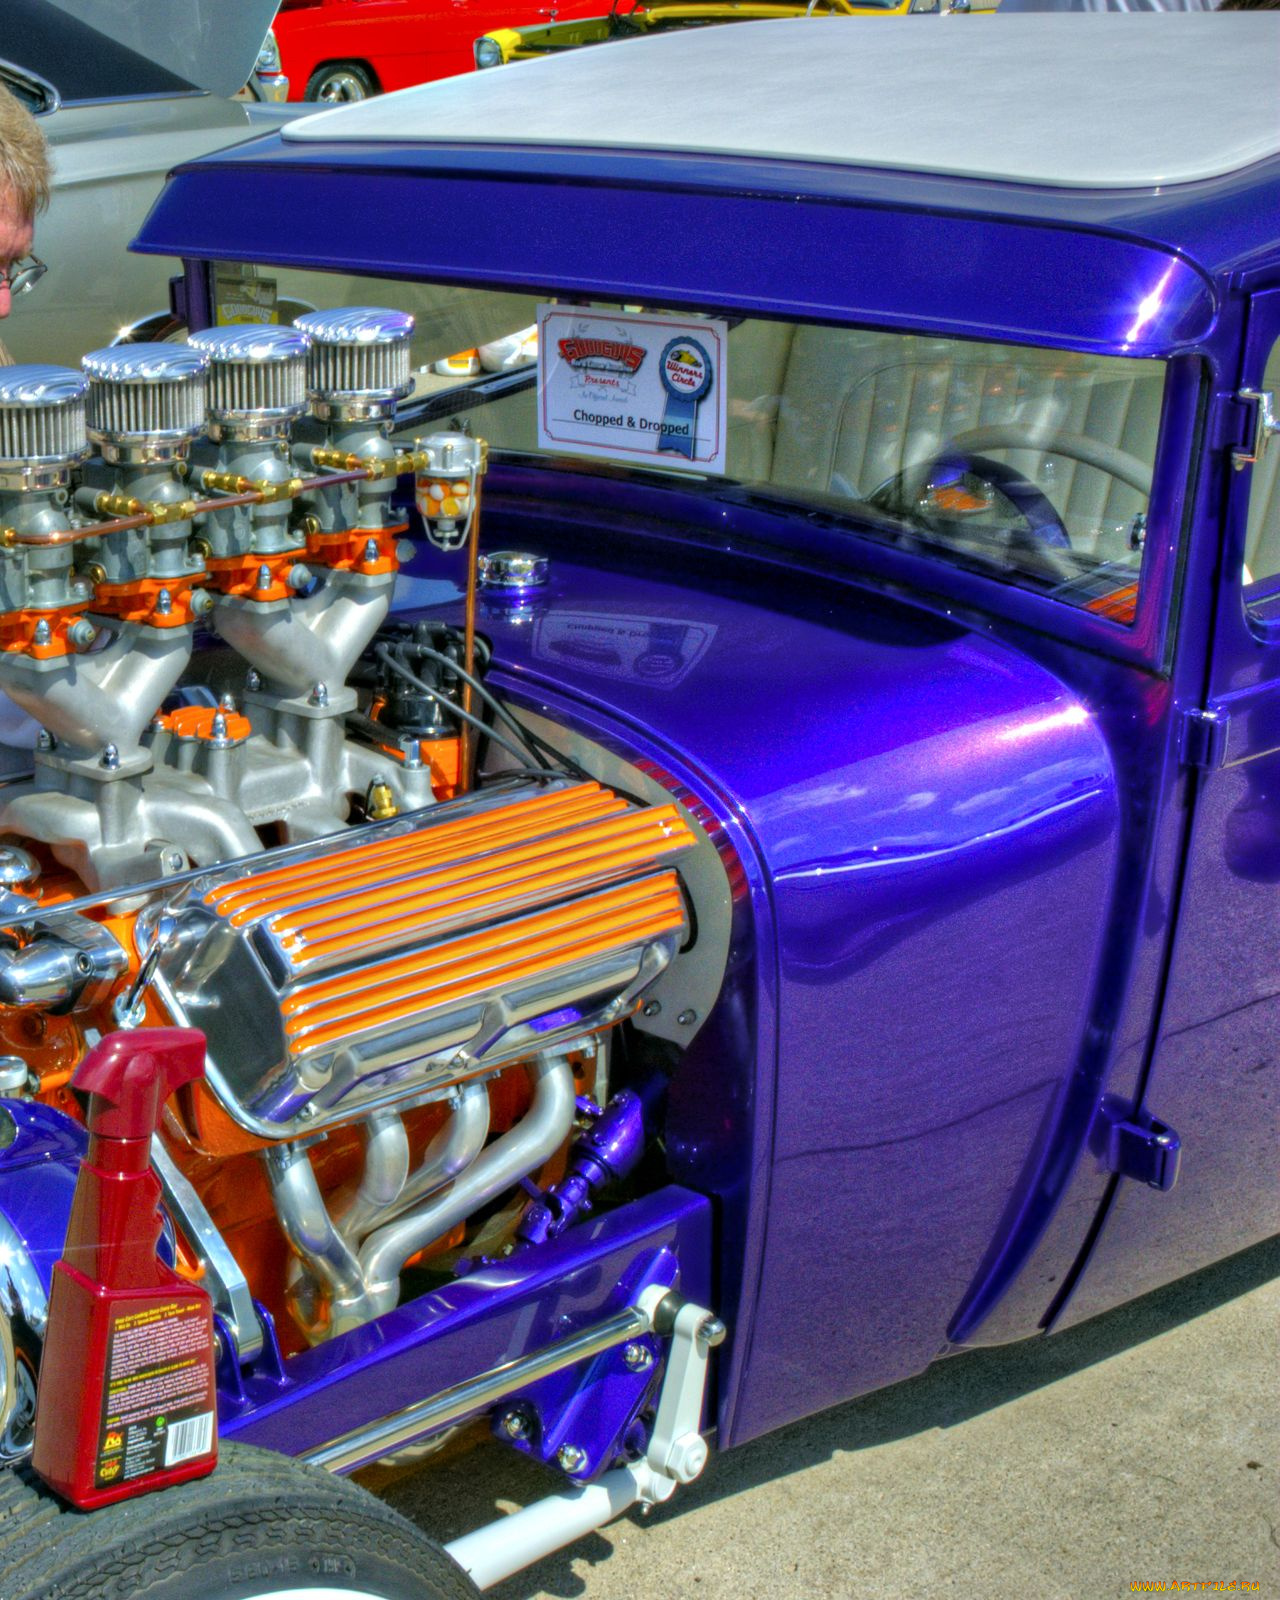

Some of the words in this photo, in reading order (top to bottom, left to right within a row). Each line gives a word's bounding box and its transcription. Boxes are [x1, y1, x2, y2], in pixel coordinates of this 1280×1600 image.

[666, 360, 703, 379] Winners
[584, 374, 620, 387] Presents
[573, 408, 623, 427] Chopped
[626, 416, 636, 427] &
[639, 418, 690, 436] Dropped
